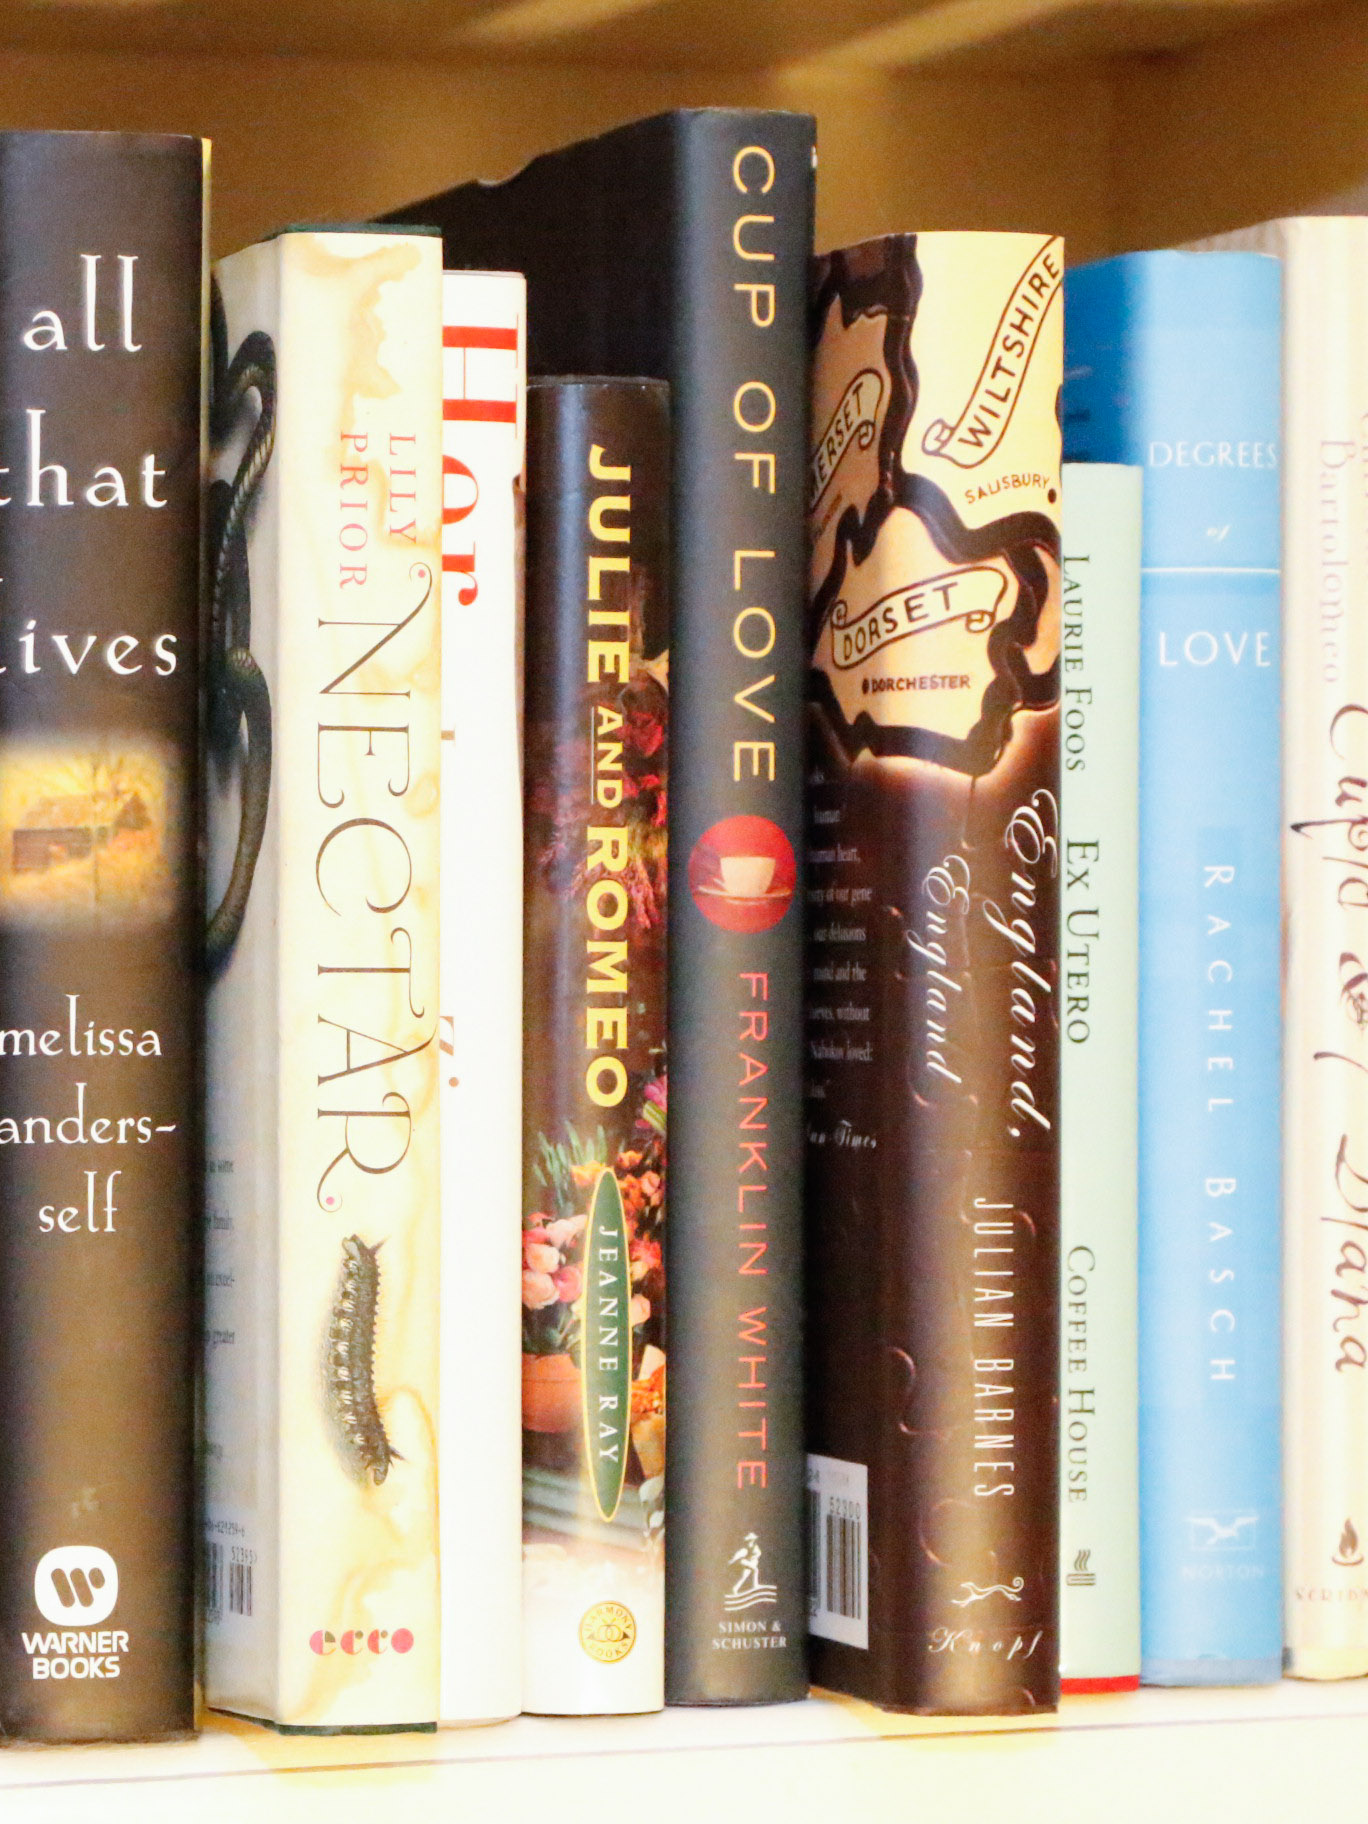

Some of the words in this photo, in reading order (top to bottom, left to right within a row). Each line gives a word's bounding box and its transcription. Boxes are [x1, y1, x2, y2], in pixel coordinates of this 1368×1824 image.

[733, 145, 776, 327] CUP
[24, 255, 142, 353] all
[957, 252, 1061, 452] WILTSHIRE
[389, 433, 417, 545] LILY
[733, 381, 776, 494] OF
[964, 472, 1050, 505] SALISBURY
[1149, 440, 1278, 470] DEGREES
[339, 433, 369, 590] PRIOR
[587, 443, 633, 685] JULIE
[733, 550, 776, 782] LOVE
[840, 581, 960, 661] DORSET
[1063, 555, 1090, 673] LAURIE
[1159, 630, 1272, 667] LOVE
[871, 674, 971, 692] DORCHESTER
[1065, 687, 1093, 771] FOOS
[595, 705, 624, 808] AND
[315, 561, 436, 1215] NECTAR
[1066, 839, 1100, 890] EX
[586, 825, 632, 1108] ROMEO
[905, 854, 970, 1084] England
[982, 788, 1059, 1138] England,
[1066, 908, 1100, 1044] UTERO
[1204, 865, 1233, 1114] RACHEL
[737, 972, 769, 1276] FRANKLIN
[38, 1171, 122, 1233] self
[599, 1225, 619, 1374] JEANNE
[974, 1196, 1015, 1330] JULIAN
[1066, 1245, 1096, 1374] COFFEE
[1206, 1177, 1236, 1382] BASCH
[599, 1398, 620, 1465] RAY
[737, 1306, 767, 1491] WHITE
[974, 1358, 1016, 1498] BARNES
[1067, 1387, 1096, 1502] HOUSE
[22, 1631, 129, 1656] WARNER
[32, 1656, 120, 1679] BOOKS
[309, 1629, 415, 1657] ecco
[712, 1636, 788, 1653] SCHUSTER
[718, 1620, 765, 1635] SIMON
[771, 1619, 782, 1632] &
[928, 1626, 1043, 1661] Knopf
